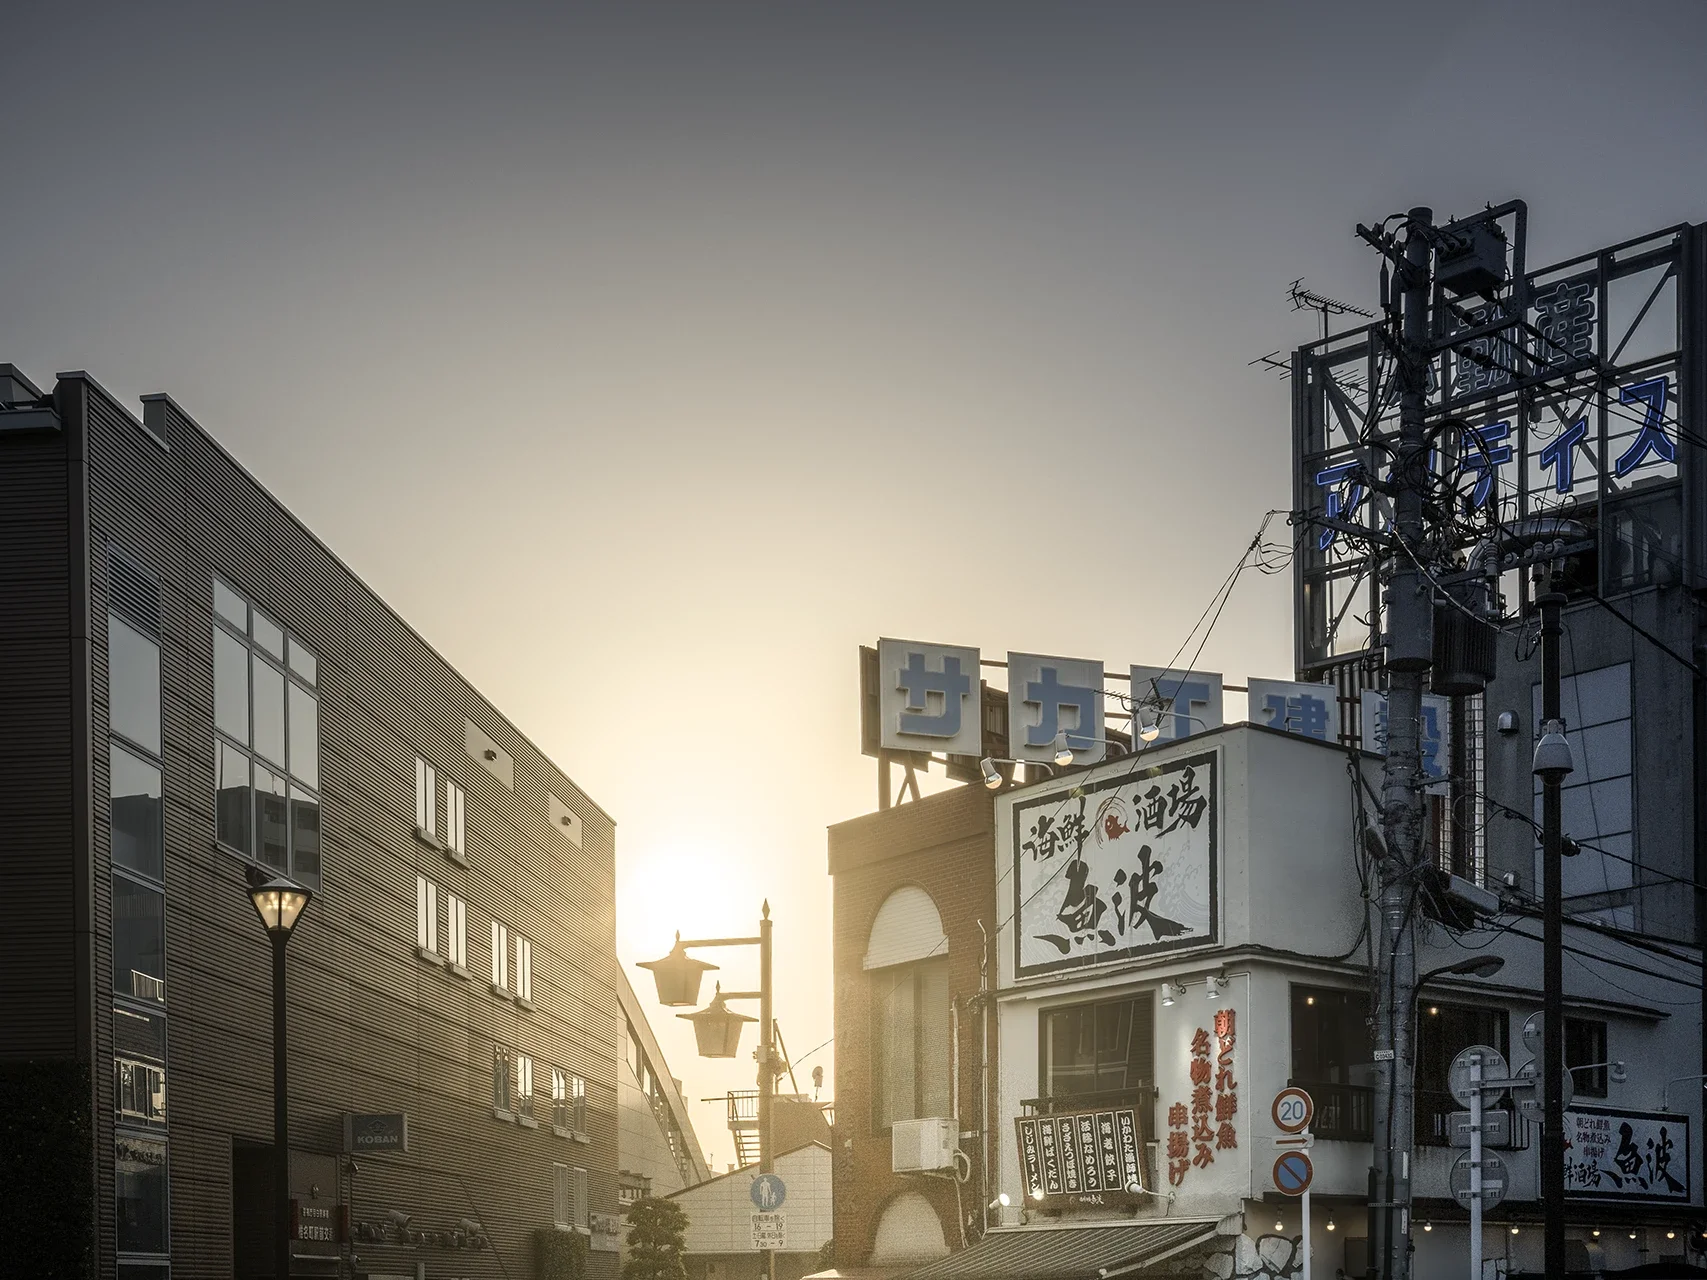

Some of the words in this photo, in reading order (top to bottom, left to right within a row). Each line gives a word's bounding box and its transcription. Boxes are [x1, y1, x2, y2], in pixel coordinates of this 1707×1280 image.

[1384, 282, 1597, 404] 動産
[1022, 794, 1090, 863] 海鮮
[1133, 765, 1207, 839] 酒場
[1033, 844, 1194, 955] 魚波
[1189, 1027, 1215, 1169] 名物煮込み
[1213, 1008, 1238, 1151] 朝どれ鮮魚
[1280, 1101, 1304, 1121] 20
[357, 1135, 398, 1144] KOBAN
[1167, 1101, 1191, 1187] 串揚げ
[1600, 1122, 1687, 1194] 魚波
